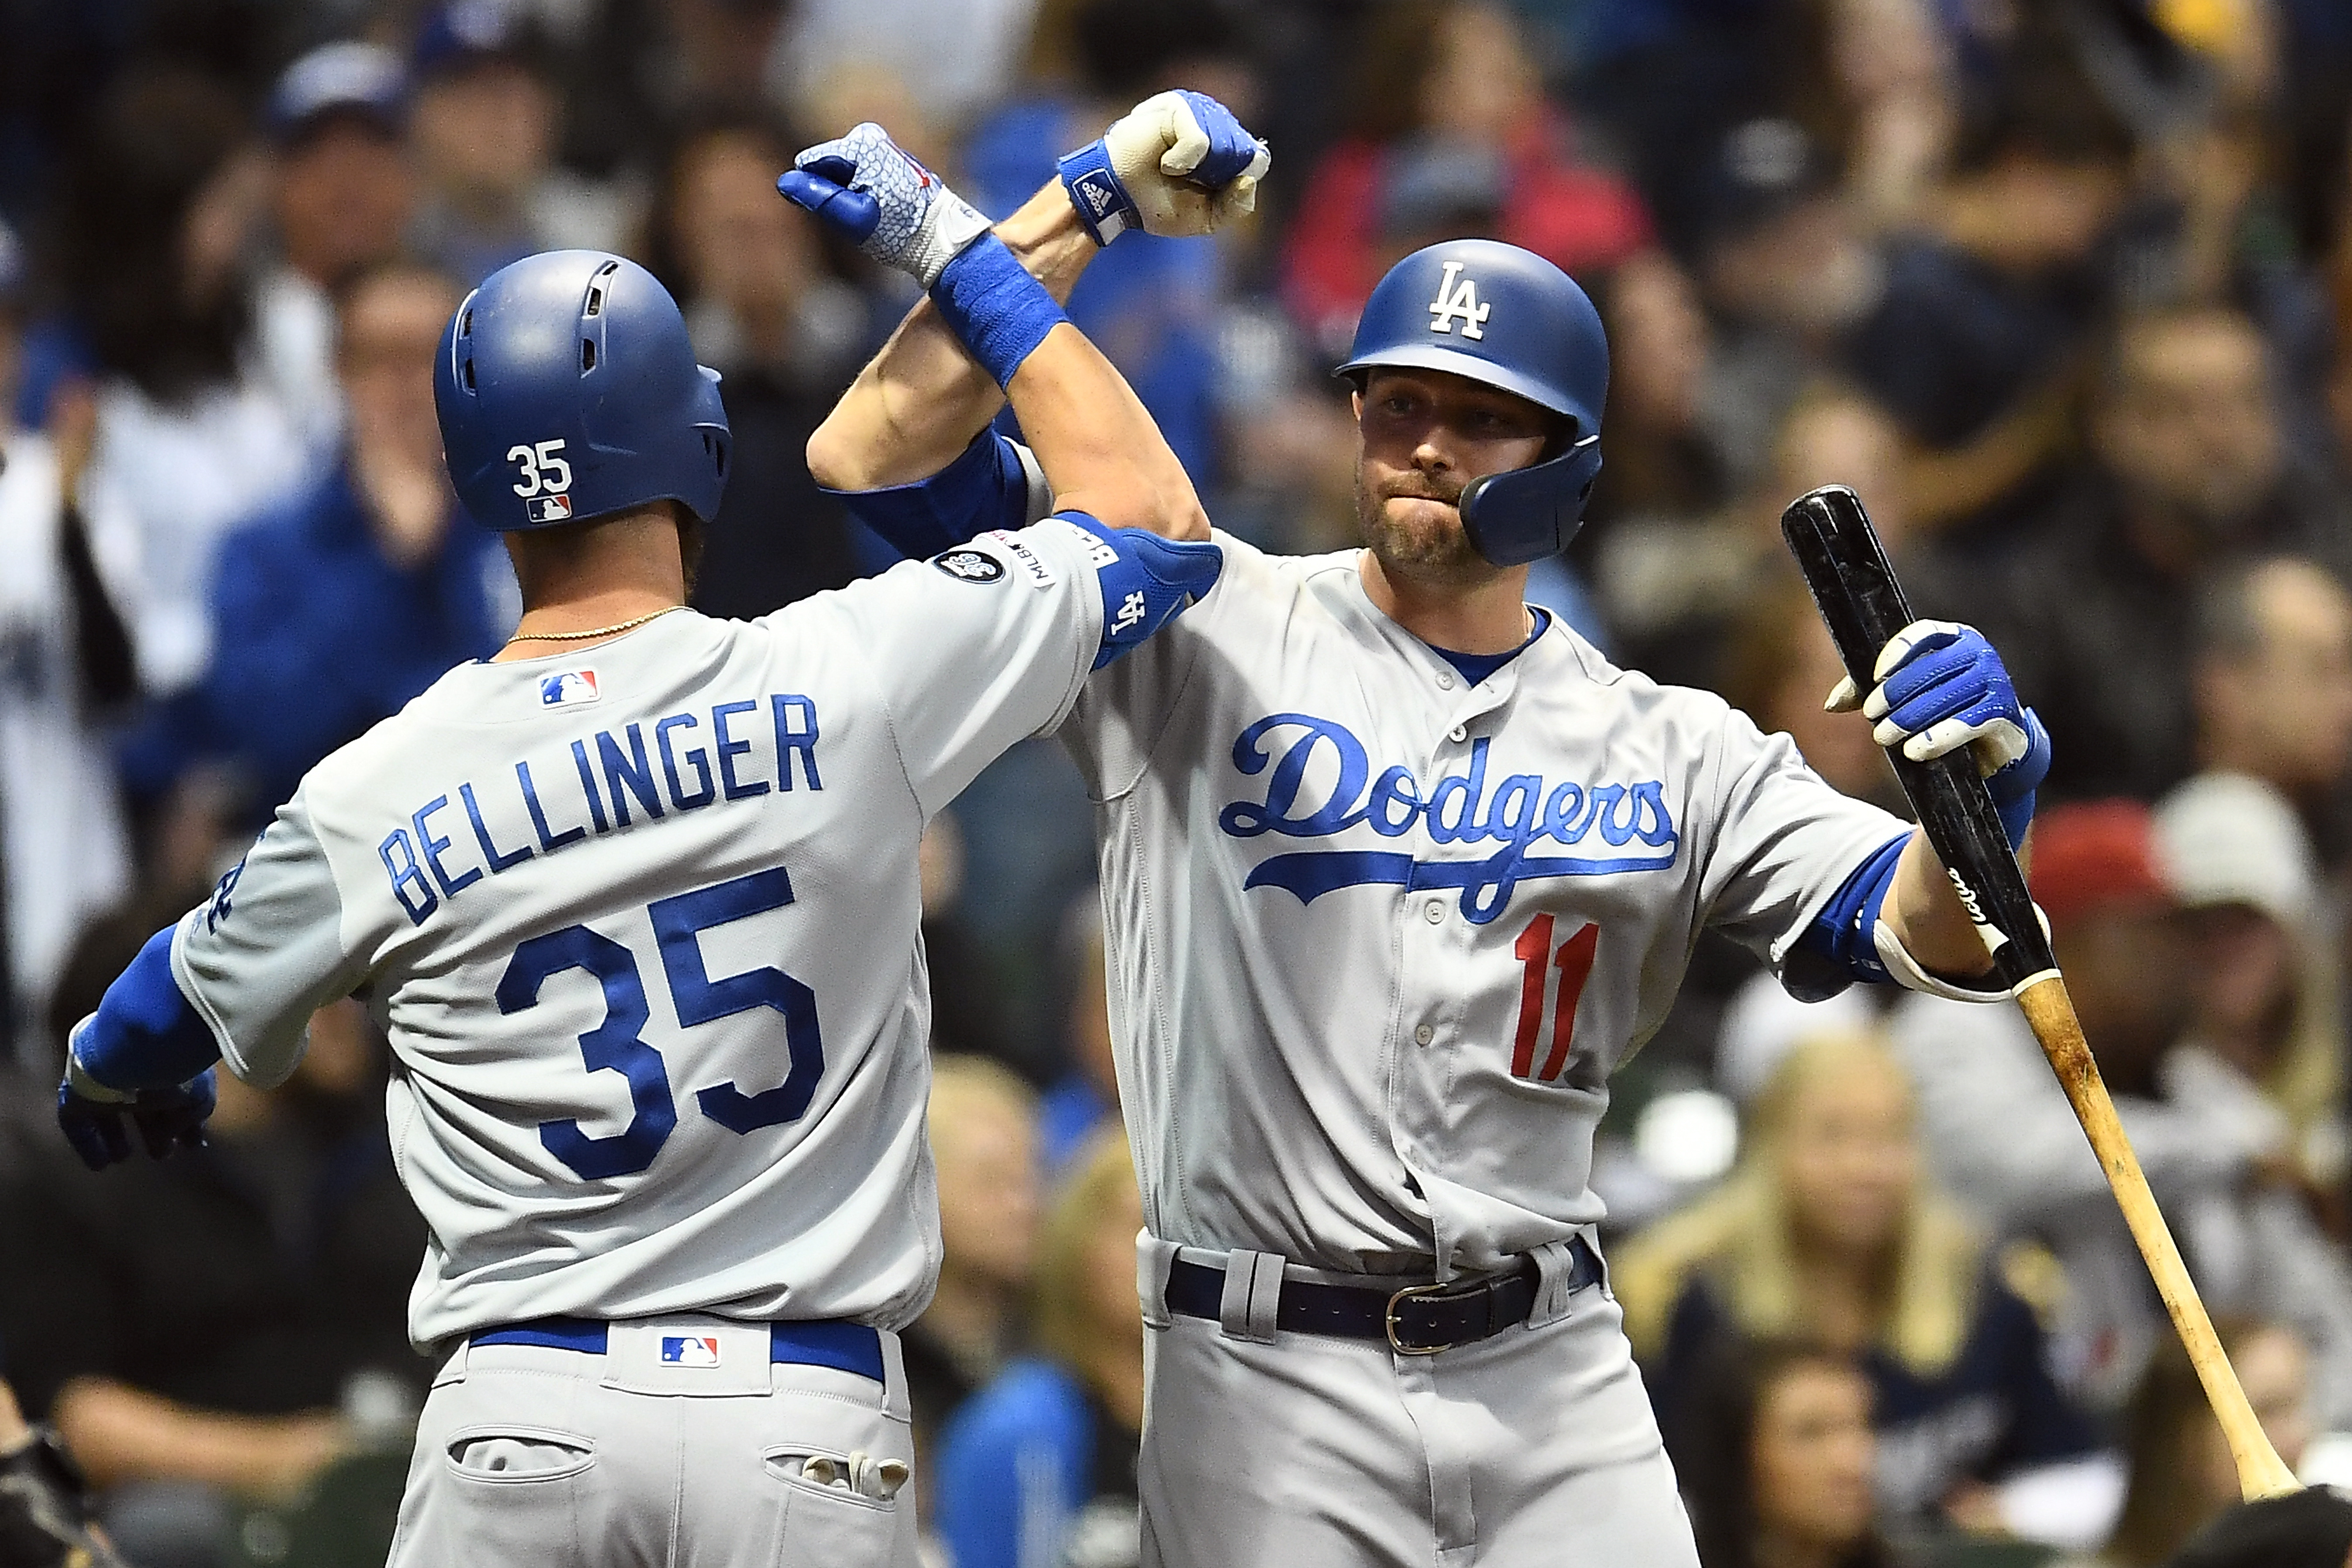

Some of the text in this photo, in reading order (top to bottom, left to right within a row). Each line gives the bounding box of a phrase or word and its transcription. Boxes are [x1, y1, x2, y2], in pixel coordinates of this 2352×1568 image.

[1429, 261, 1491, 340] LA
[506, 438, 572, 497] 35
[377, 693, 823, 928] BELLINGER
[1218, 712, 1680, 925] Dodgers
[494, 865, 826, 1181] 35
[1511, 912, 1600, 1082] 11
